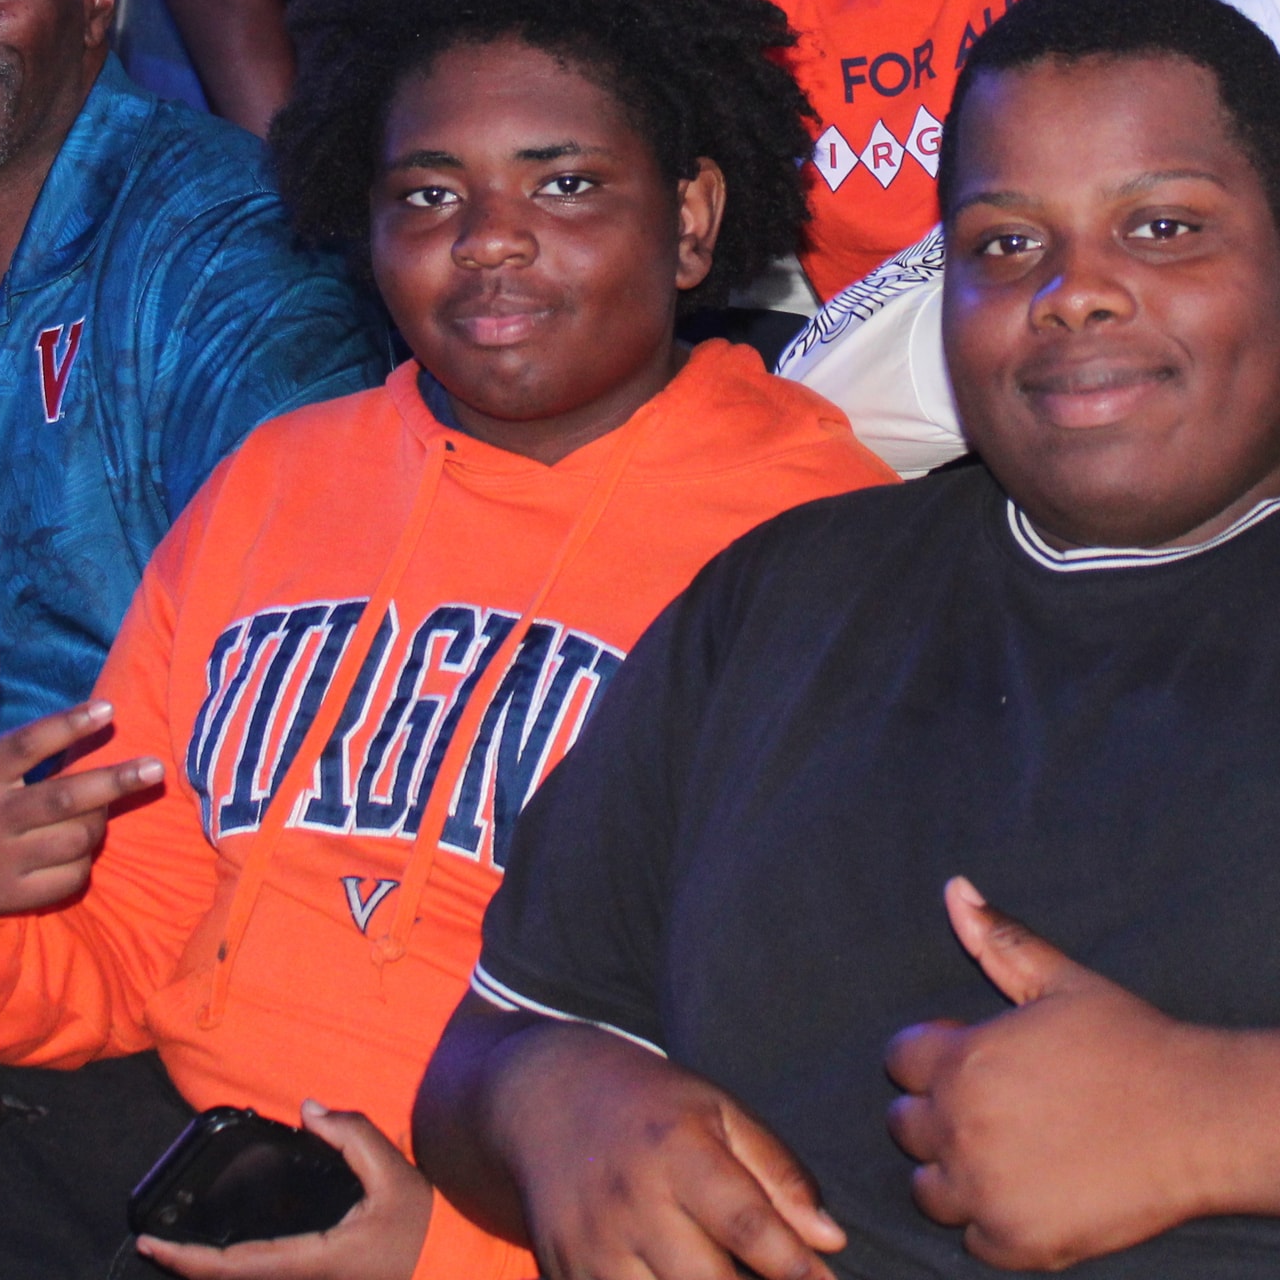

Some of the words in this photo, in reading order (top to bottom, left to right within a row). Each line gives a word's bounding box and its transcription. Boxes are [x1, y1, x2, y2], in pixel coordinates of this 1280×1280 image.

[840, 38, 937, 105] FOR
[34, 314, 86, 424] V
[340, 876, 400, 934] V
